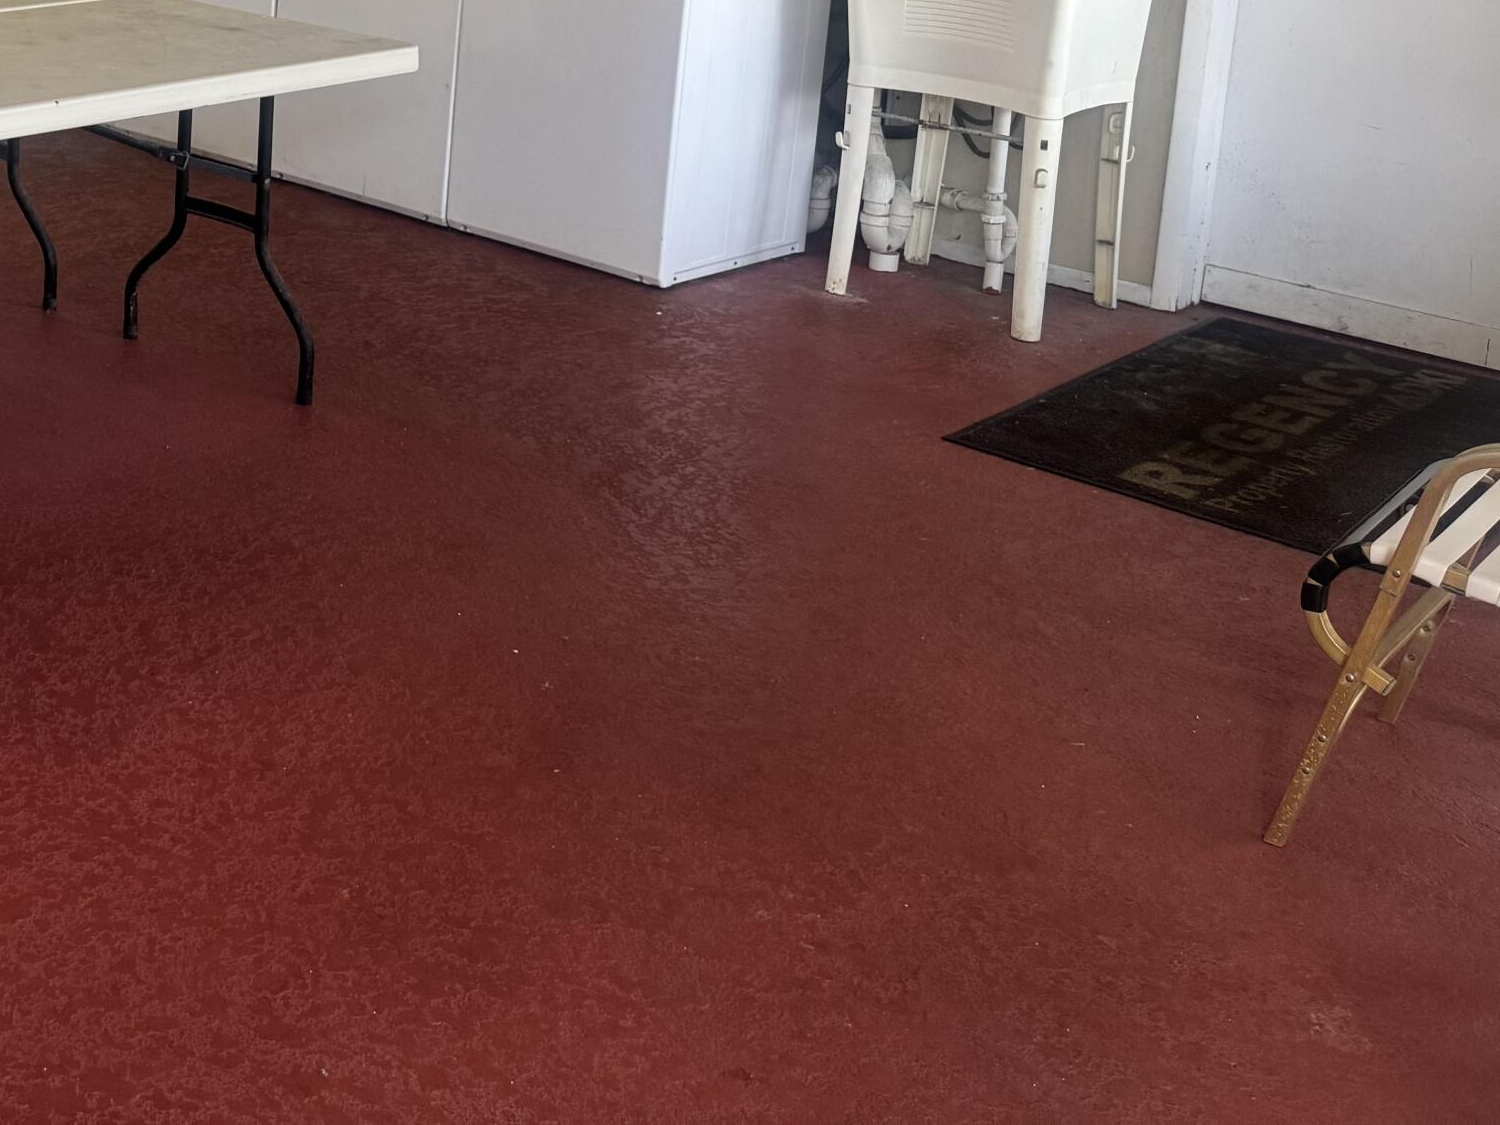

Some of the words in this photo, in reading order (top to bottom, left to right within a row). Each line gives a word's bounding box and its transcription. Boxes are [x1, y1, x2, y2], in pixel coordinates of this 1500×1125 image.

[1116, 350, 1404, 501] REGENCY
[1202, 460, 1318, 514] Property
[1285, 401, 1404, 463] Restoration
